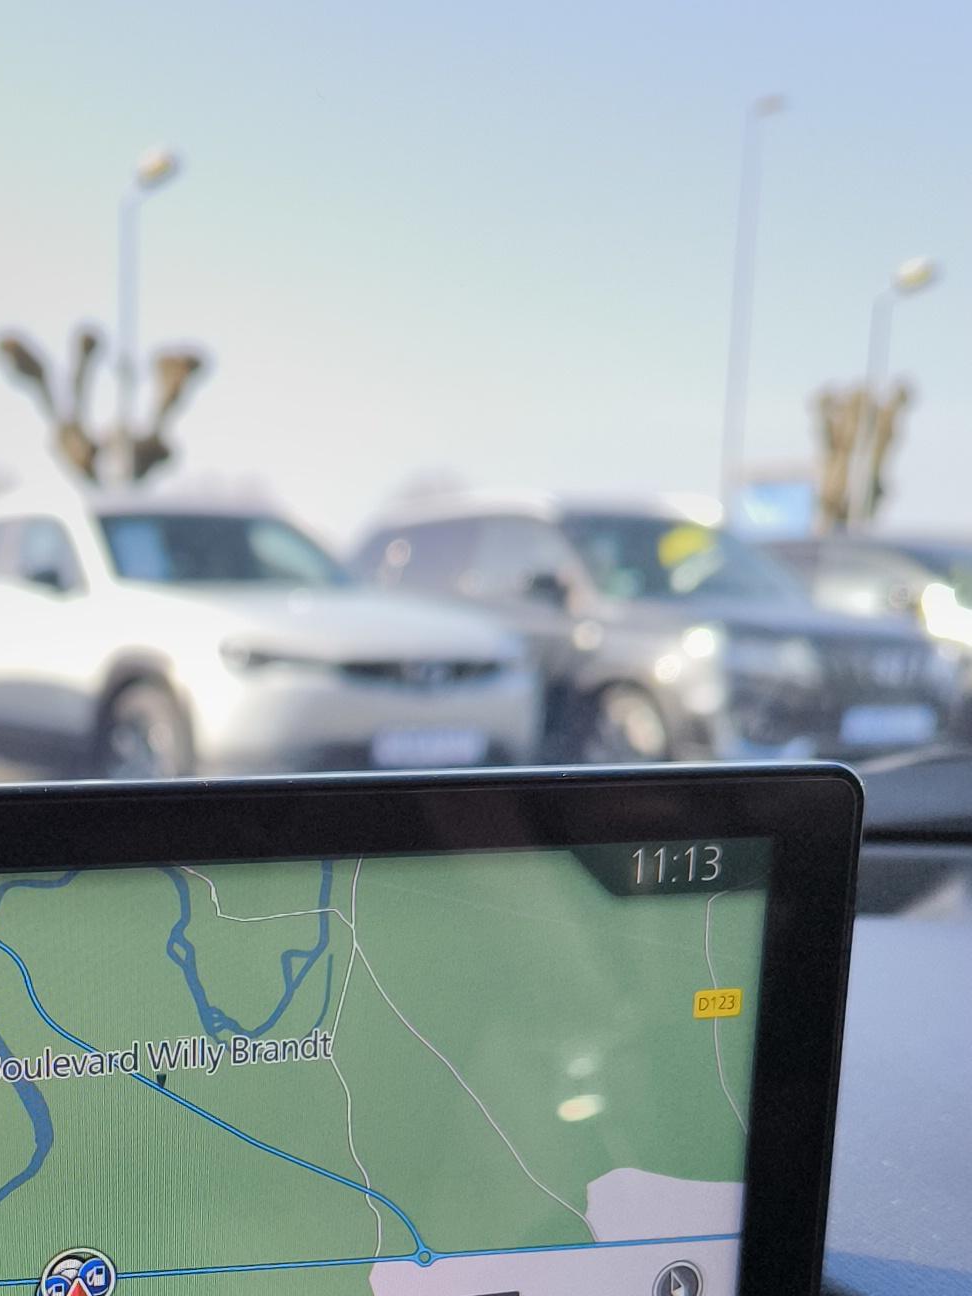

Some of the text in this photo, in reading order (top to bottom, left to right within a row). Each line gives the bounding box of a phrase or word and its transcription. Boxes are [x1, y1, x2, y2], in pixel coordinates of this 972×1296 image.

[632, 846, 721, 884] 11:13
[697, 995, 736, 1012] D123
[148, 1036, 225, 1074] Willy
[231, 1029, 332, 1066] Brandt
